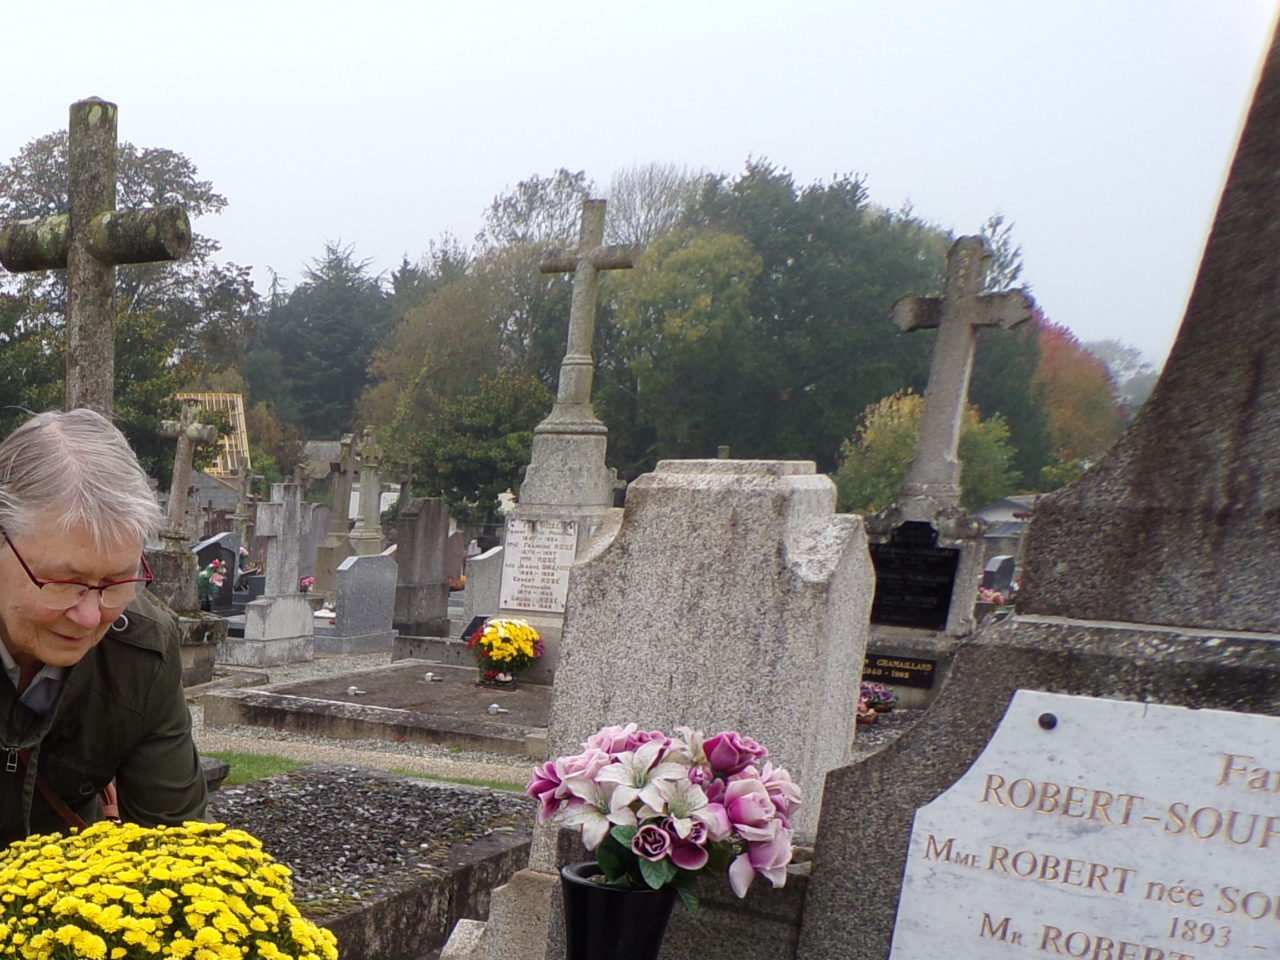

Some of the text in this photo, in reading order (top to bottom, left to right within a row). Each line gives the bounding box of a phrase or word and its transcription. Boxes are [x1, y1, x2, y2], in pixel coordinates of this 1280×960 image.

[987, 845, 1138, 894] ROBERT
[1144, 879, 1206, 909] née
[1216, 886, 1280, 922] SO
[1168, 917, 1232, 949] 1893
